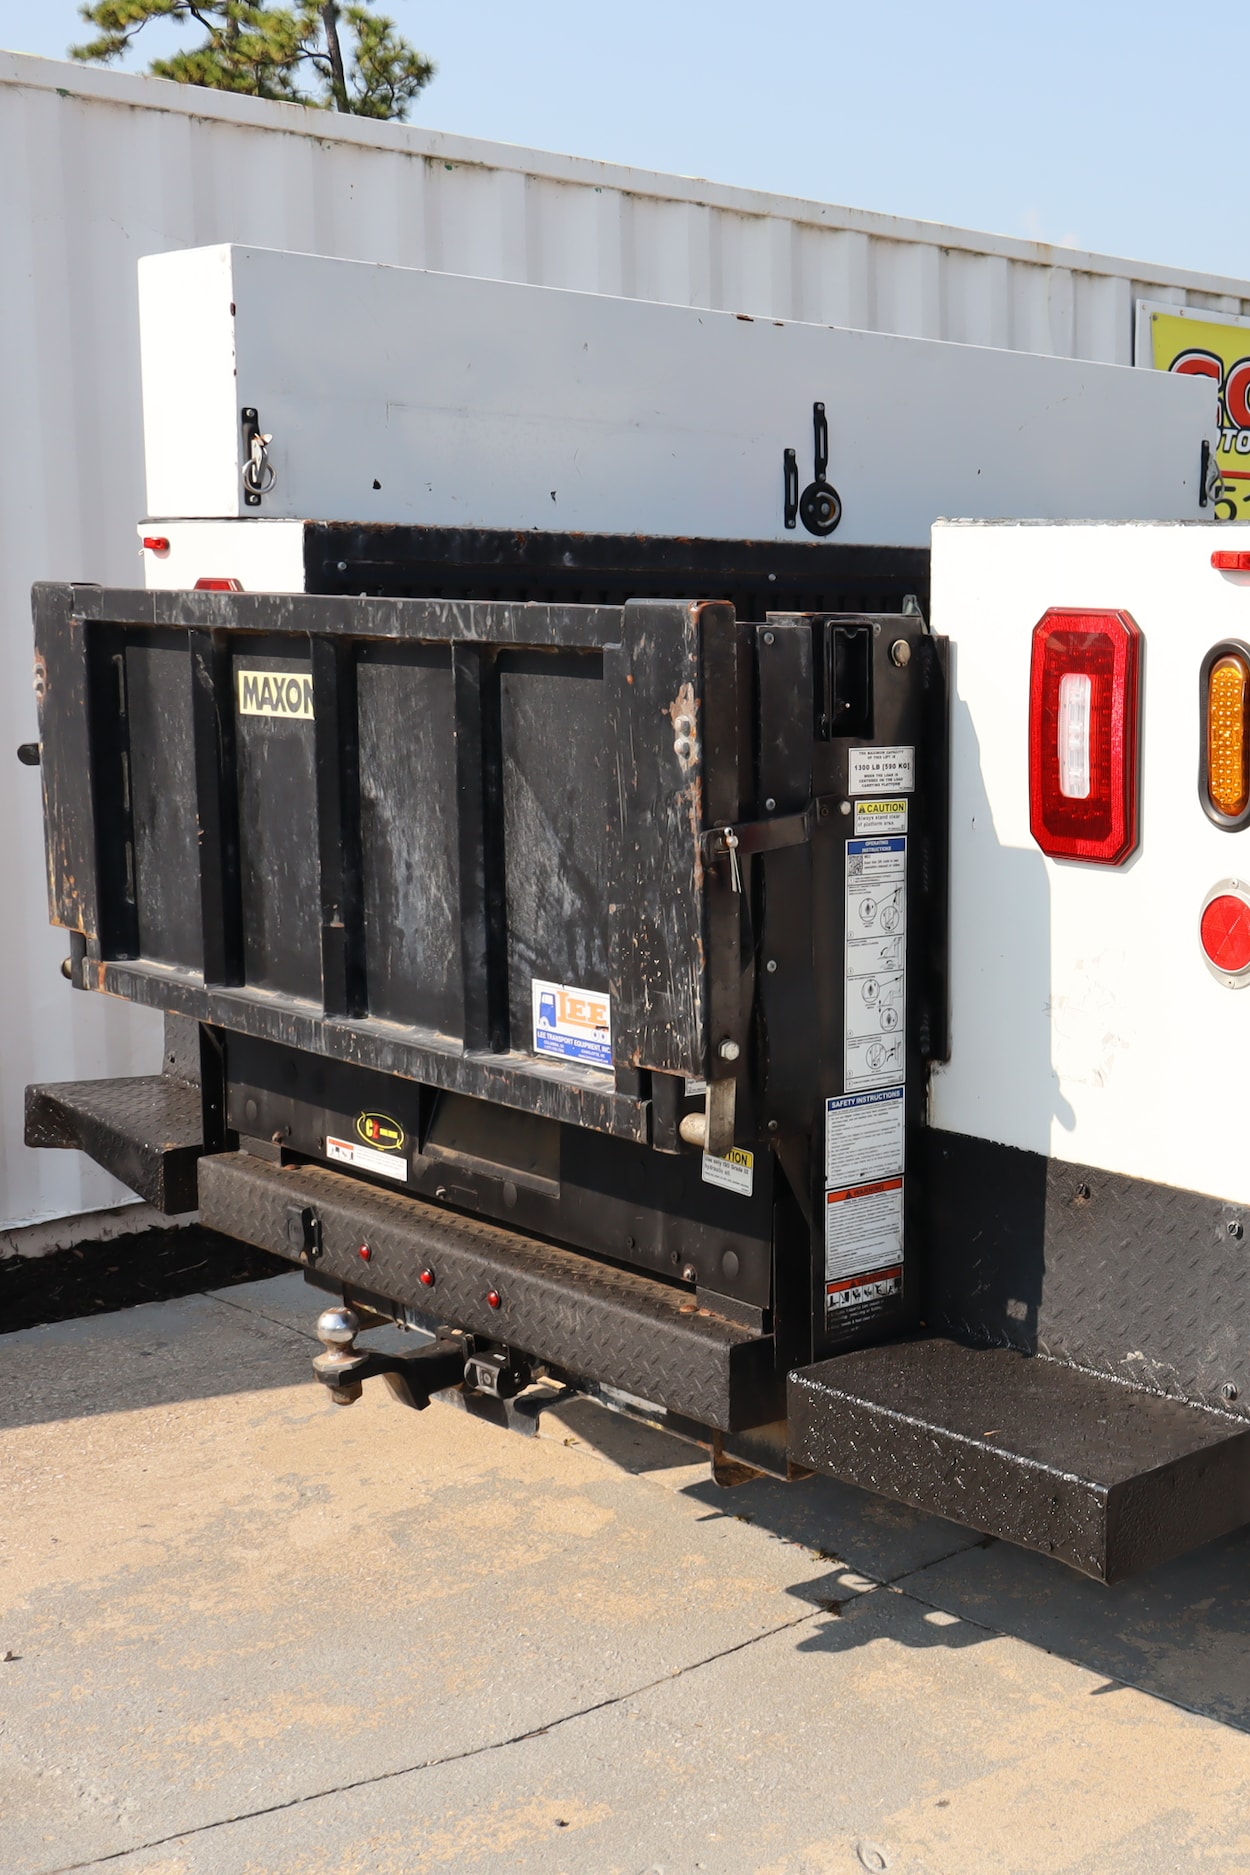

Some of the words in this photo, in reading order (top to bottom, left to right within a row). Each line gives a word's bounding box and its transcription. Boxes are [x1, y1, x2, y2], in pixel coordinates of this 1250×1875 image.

[242, 675, 314, 714] MAXON
[866, 803, 904, 812] CAUTION
[537, 1030, 547, 1039] LEE
[546, 1032, 574, 1046] TRANSPORT
[831, 1098, 857, 1109] SAFETY
[855, 1090, 901, 1104] INSTRUCTIONS
